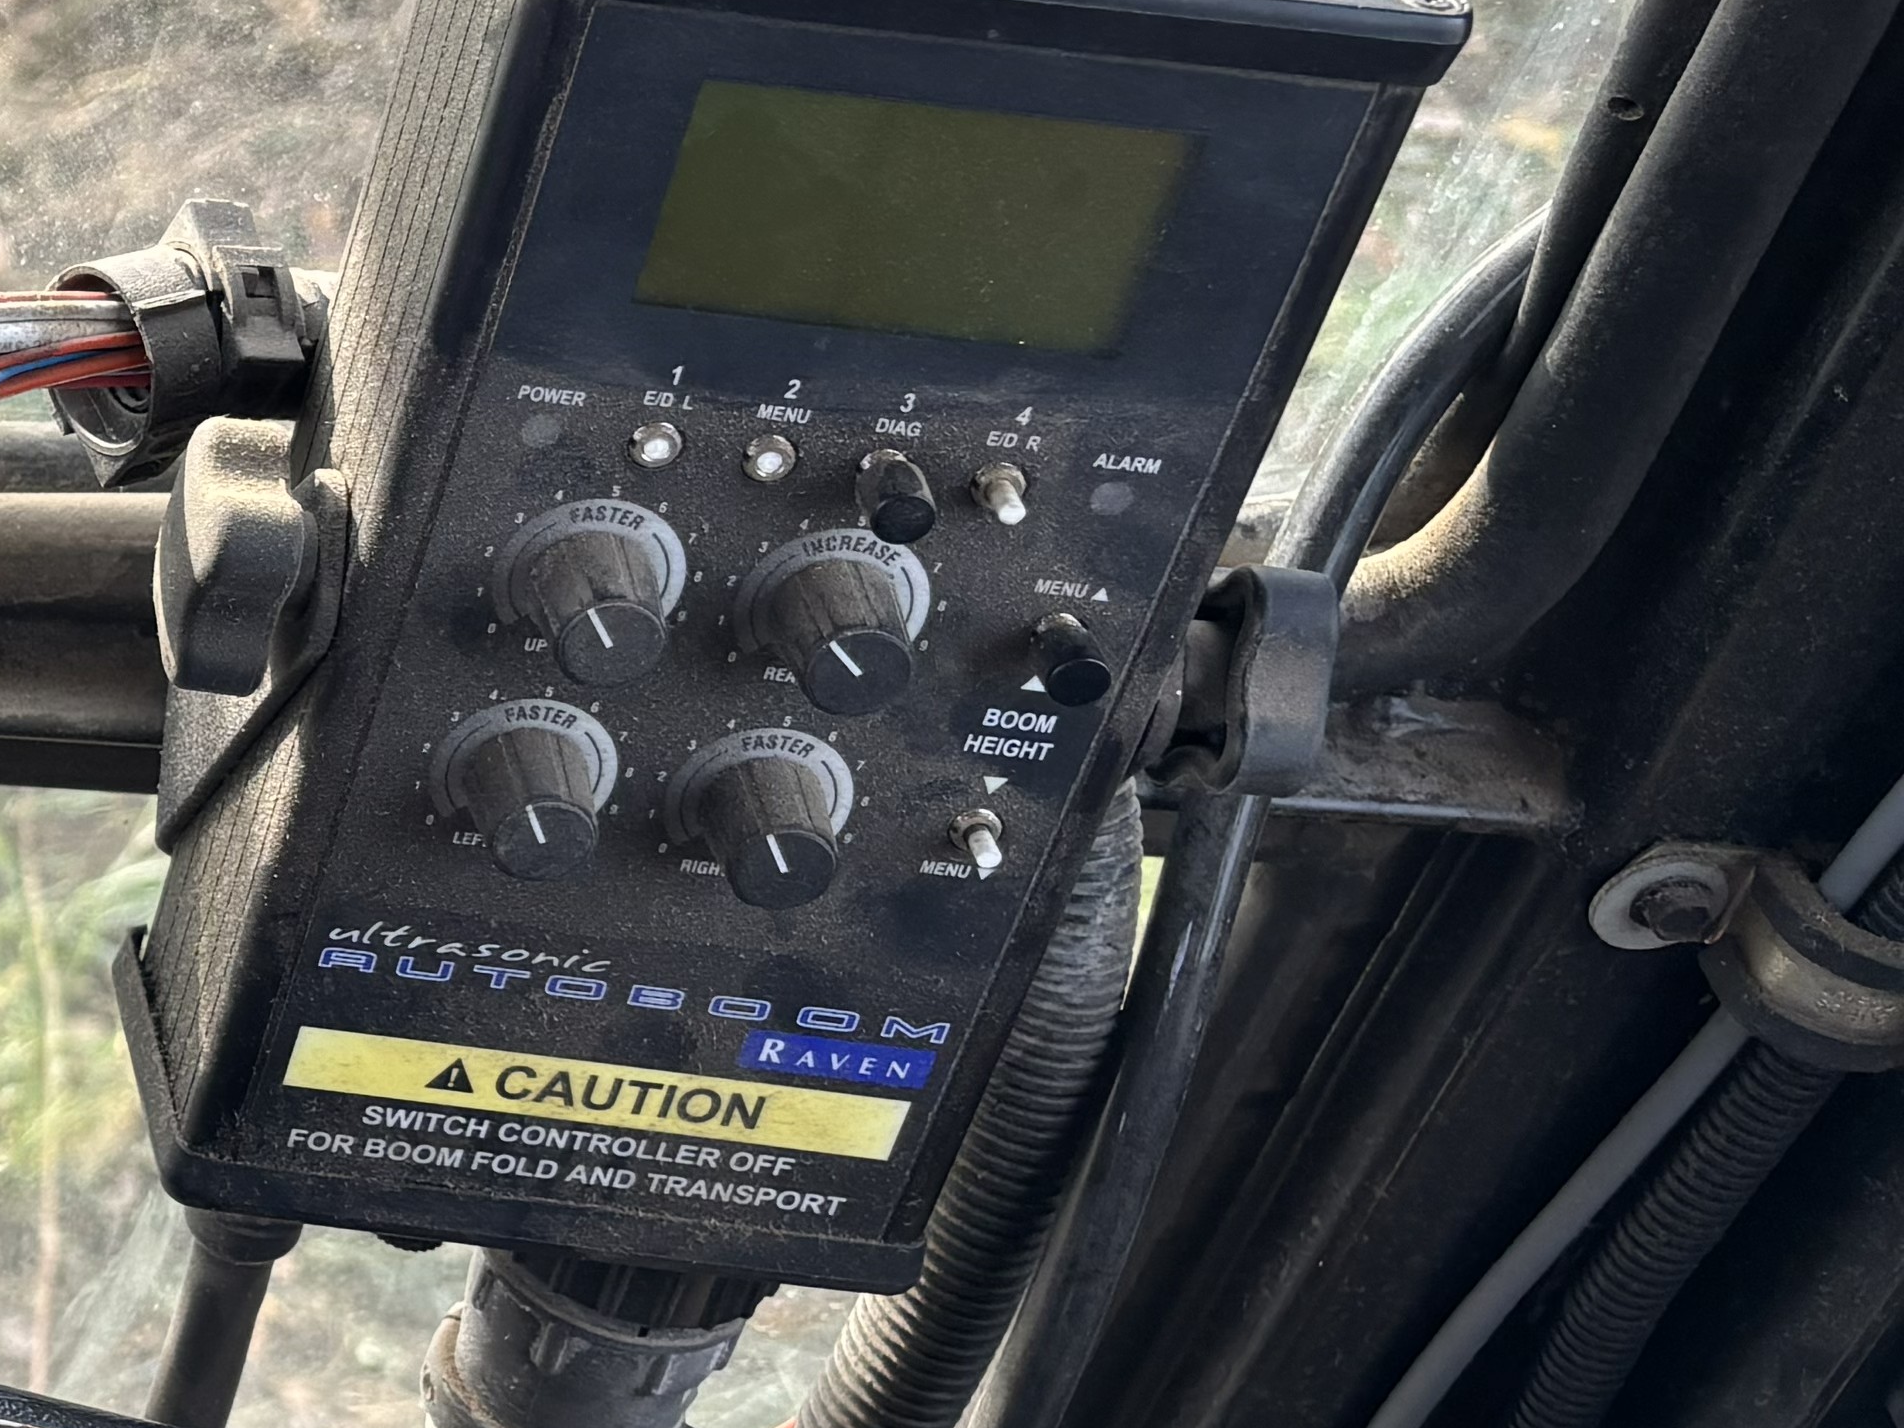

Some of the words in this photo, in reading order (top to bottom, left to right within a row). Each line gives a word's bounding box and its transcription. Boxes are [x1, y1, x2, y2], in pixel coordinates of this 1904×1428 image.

[672, 365, 685, 385] 1
[784, 379, 801, 400] 2
[518, 385, 586, 407] POWER
[643, 391, 673, 407] E/D
[682, 395, 693, 410] L
[900, 393, 916, 413] 3
[756, 403, 812, 424] MENU
[1015, 406, 1033, 426] 4
[875, 417, 922, 437] DIAG
[987, 431, 1018, 449] E/D
[1025, 435, 1041, 452] R
[1093, 452, 1162, 474] ALARM
[554, 490, 564, 501] 4
[611, 486, 621, 497] 5
[658, 502, 668, 513] 6
[514, 513, 525, 524] 3
[569, 505, 646, 531] FASTER
[799, 519, 809, 530] 4
[688, 533, 697, 545] 7
[484, 547, 493, 557] 2
[758, 541, 768, 553] 3
[802, 535, 903, 567] INCREASE
[933, 562, 942, 574] 7
[694, 571, 702, 583] 8
[727, 575, 736, 587] 2
[477, 588, 483, 597] 1
[1033, 578, 1089, 598] MENU
[937, 600, 946, 612] 8
[677, 610, 686, 622] 9
[718, 615, 724, 625] 1
[487, 623, 496, 634] 0
[919, 639, 929, 651] 9
[728, 652, 736, 663] 0
[763, 666, 796, 683] REA
[489, 689, 498, 700] 4
[545, 686, 554, 698] 5
[591, 701, 600, 713] 6
[451, 711, 460, 722] 3
[504, 705, 578, 729] FASTER
[783, 716, 792, 727] 5
[982, 708, 1057, 734] BOOM
[726, 719, 736, 729] 4
[619, 731, 628, 742] 7
[829, 732, 837, 742] 6
[688, 740, 697, 750] 3
[741, 734, 815, 757] FASTER
[963, 735, 1054, 761] HEIGHT
[857, 761, 865, 771] 7
[625, 767, 634, 778] 8
[657, 772, 667, 782] 2
[609, 804, 619, 815] 9
[649, 809, 654, 819] 1
[425, 814, 434, 826] 0
[453, 831, 486, 847] LEF
[843, 833, 852, 843] 9
[659, 843, 667, 853] 0
[680, 859, 726, 877] RIGH
[919, 860, 971, 879] MENU
[328, 922, 612, 972] ultrasonic
[318, 947, 951, 1044] AUTOBOOM
[759, 1038, 912, 1080] RAVEN
[495, 1066, 767, 1129] CAUTION
[362, 1105, 489, 1139] SWITCH
[497, 1122, 718, 1170] CONTROLLER
[729, 1150, 796, 1176] OFF
[287, 1128, 353, 1154] FOR
[363, 1138, 462, 1169] BOOM
[471, 1151, 559, 1181] FOLD
[566, 1163, 636, 1191] AND
[647, 1174, 847, 1217] TRANSPORT
